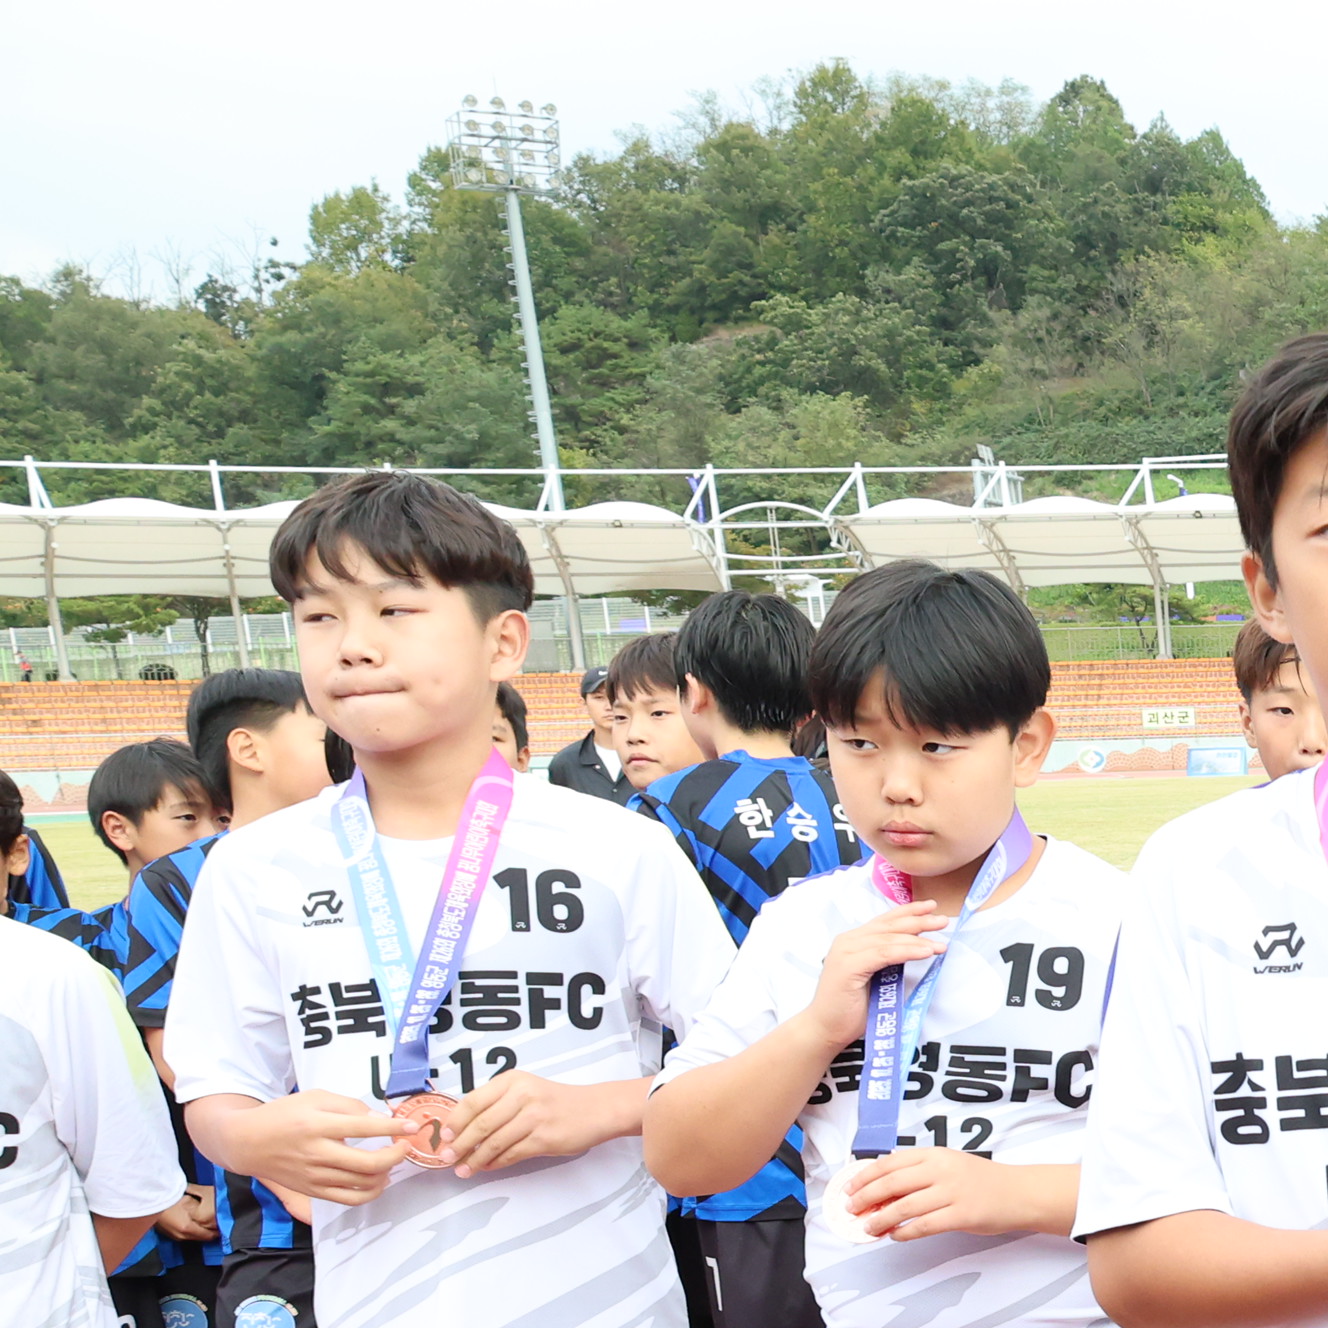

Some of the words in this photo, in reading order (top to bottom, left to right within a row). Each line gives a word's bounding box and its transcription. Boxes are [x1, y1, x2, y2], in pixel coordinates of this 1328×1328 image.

[1147, 711, 1190, 725] 괴산군
[459, 800, 499, 873] 꿈나무어린이축구대회
[436, 872, 476, 941] 충청북도체육회장배
[492, 867, 585, 933] 16
[302, 916, 344, 928] WERUN
[428, 937, 457, 965] 제26회
[999, 941, 1085, 1010] 19
[1253, 960, 1304, 974] WERUN
[290, 970, 606, 1049] 충북동FC
[876, 981, 898, 1010] 제26회
[873, 1010, 896, 1037] 영동군
